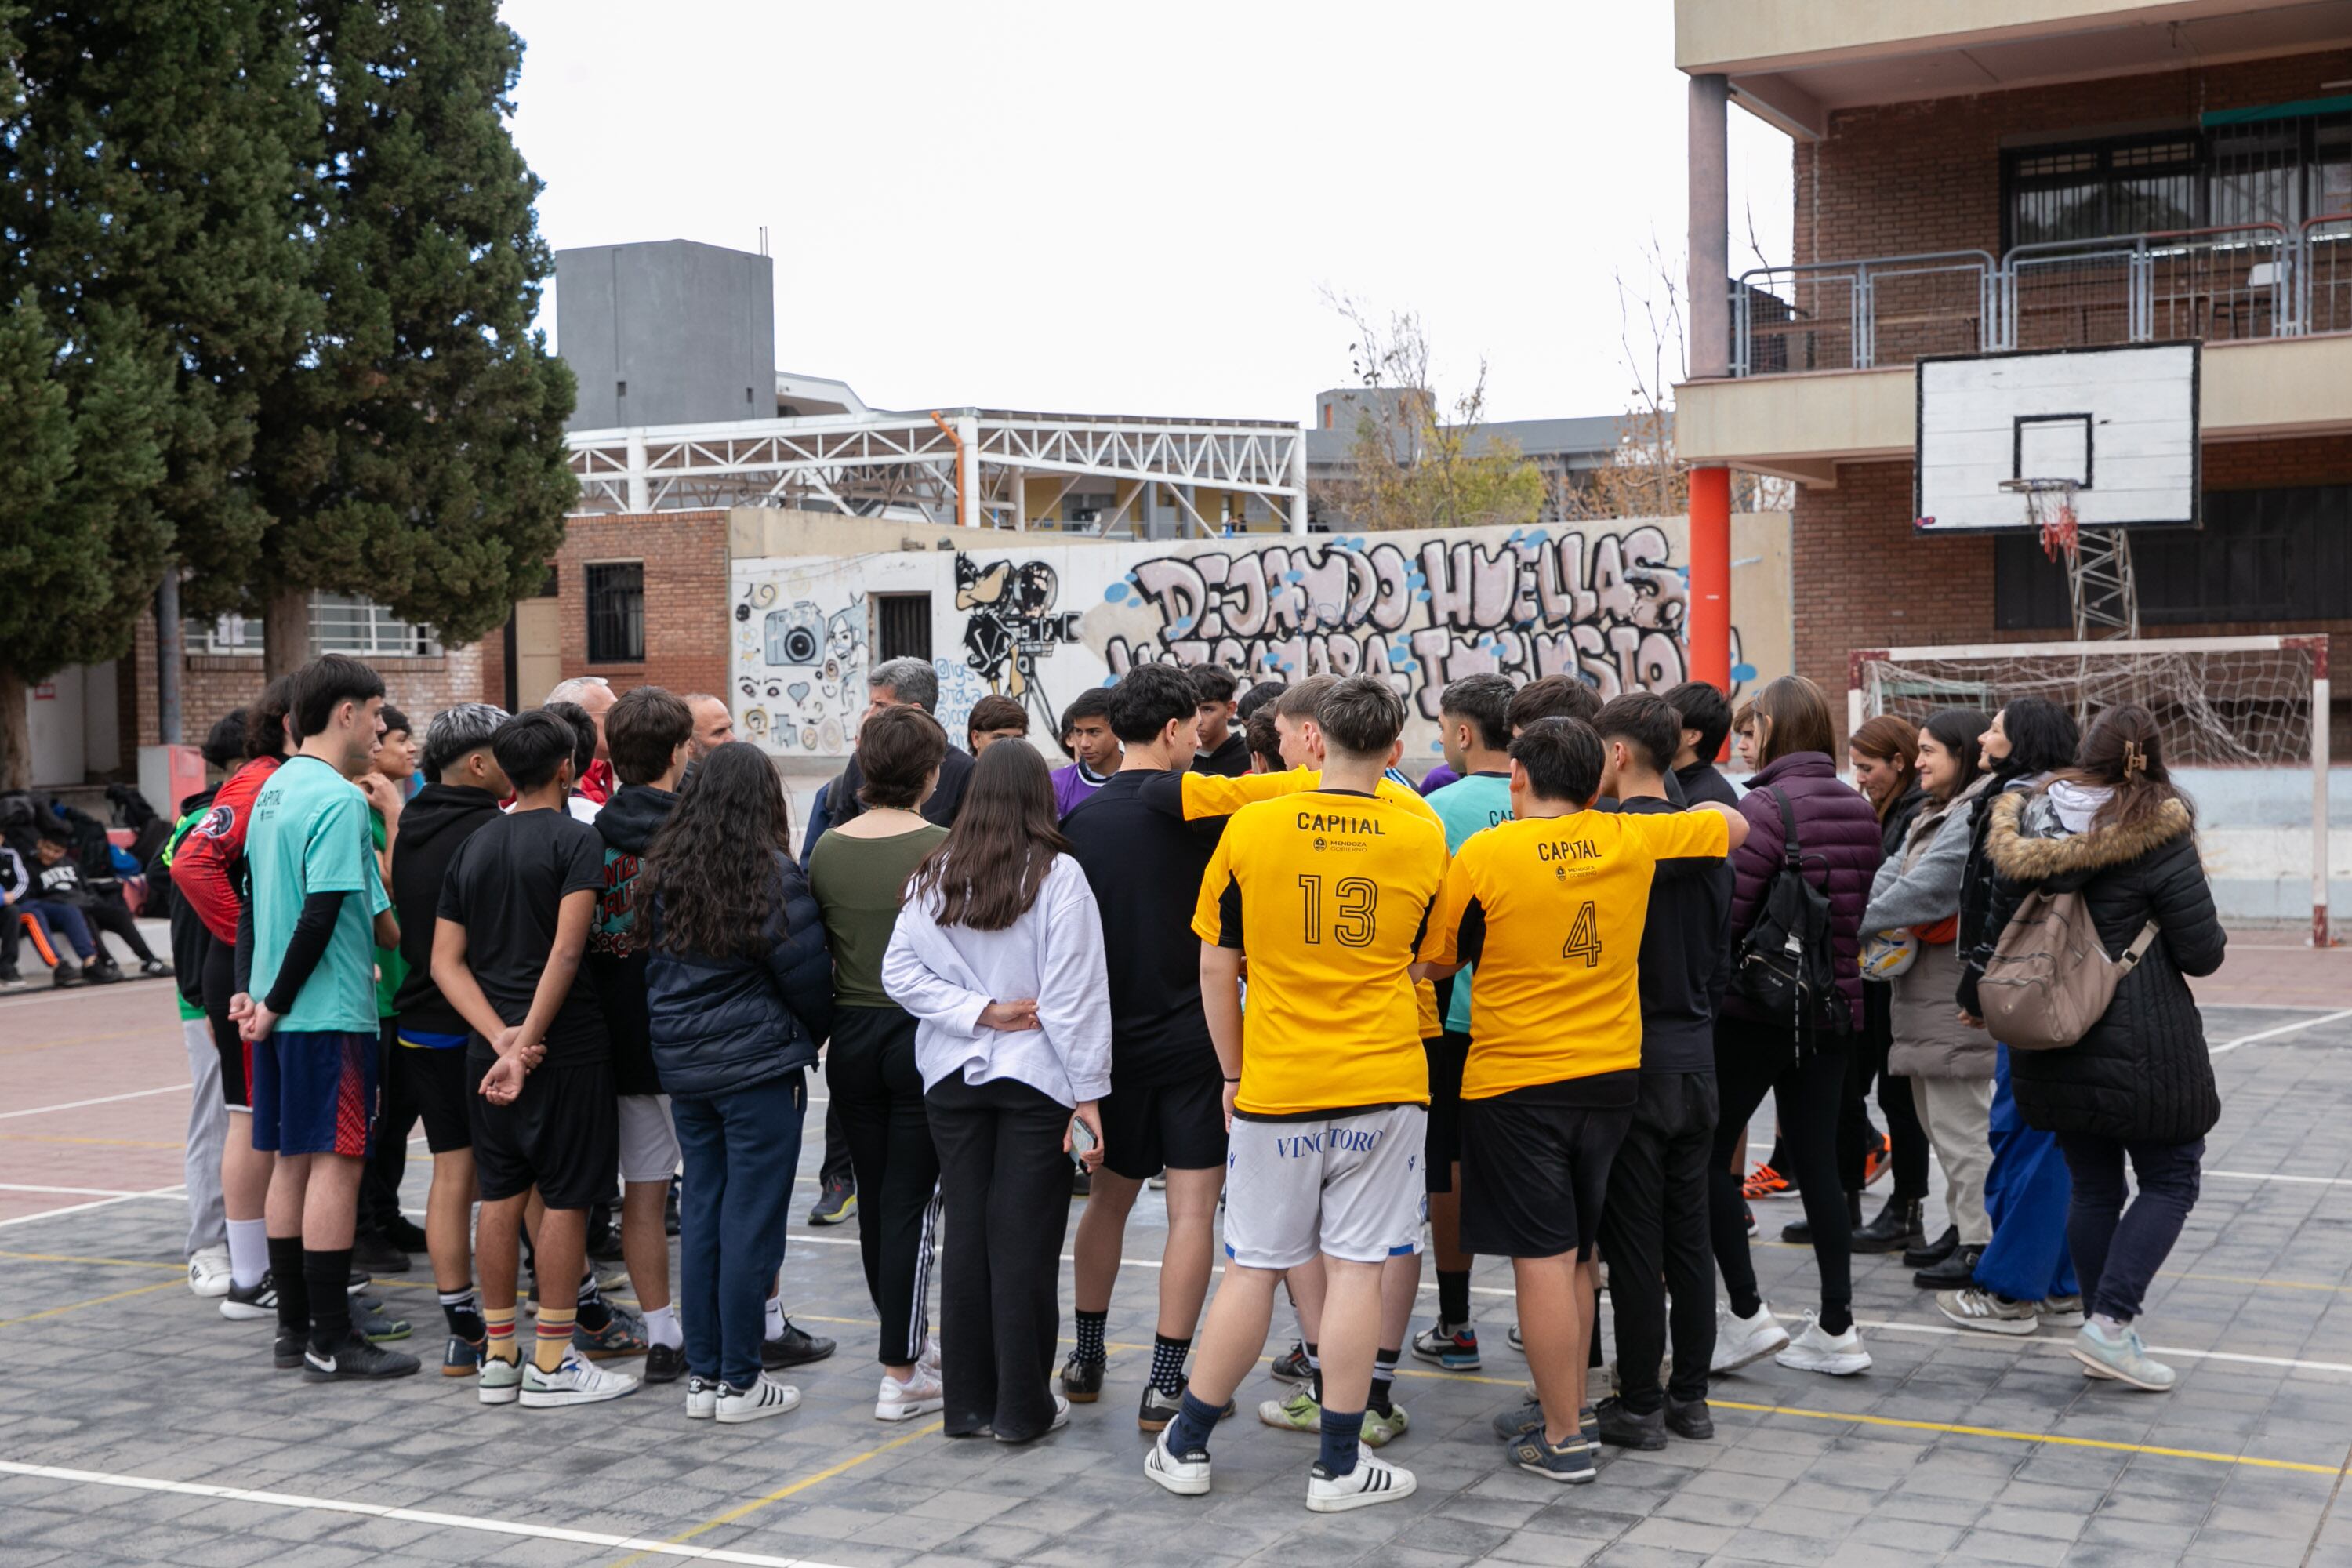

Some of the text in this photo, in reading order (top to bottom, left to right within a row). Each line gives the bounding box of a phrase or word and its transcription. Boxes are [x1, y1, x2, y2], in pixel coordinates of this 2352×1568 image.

[1131, 541, 1412, 641] DEJANDO
[1417, 524, 1690, 631] HUELLAS
[1297, 811, 1386, 835] CAPITAL
[1537, 839, 1602, 862] CAPITAL
[1298, 873, 1378, 949] 13
[1563, 900, 1602, 968] 4
